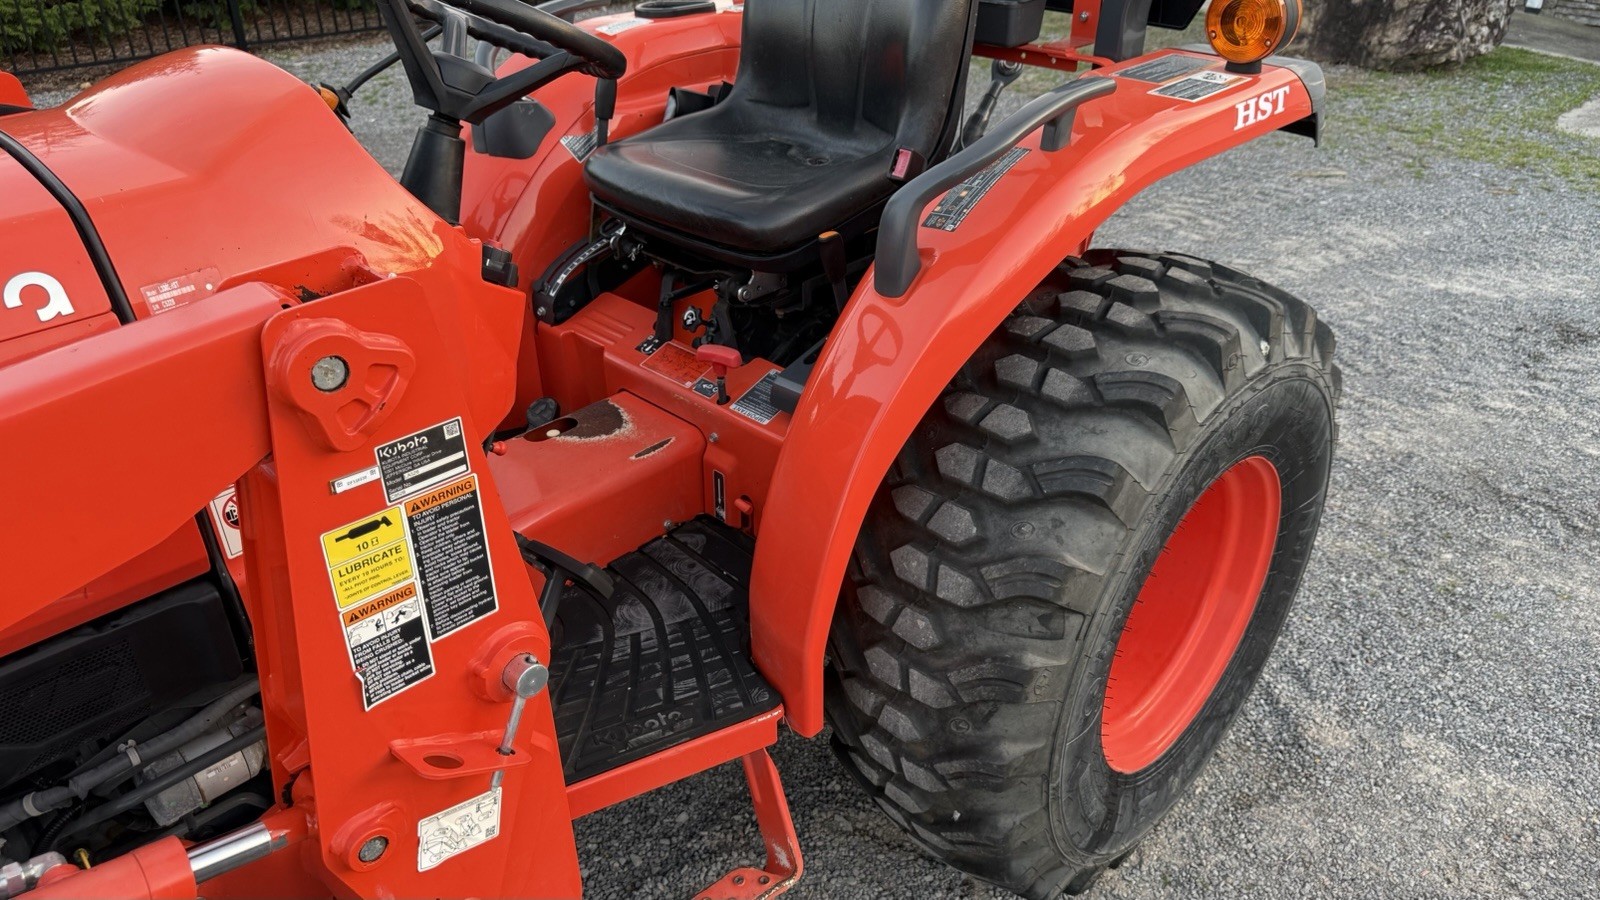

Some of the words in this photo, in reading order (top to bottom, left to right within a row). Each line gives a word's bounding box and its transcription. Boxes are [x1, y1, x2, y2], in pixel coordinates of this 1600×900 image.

[1234, 86, 1290, 131] HST
[732, 406, 766, 422] IMPORTANT
[379, 436, 428, 457] Kubota
[382, 456, 400, 465] KUBOTA
[388, 485, 403, 494] Serial
[420, 481, 472, 507] WARNING
[422, 506, 440, 516] AVOID
[441, 493, 472, 508] PERSONAL
[416, 521, 435, 531] Observe
[450, 505, 474, 518] precautions
[423, 526, 436, 534] loader
[446, 516, 460, 524] tractor
[356, 541, 369, 551] 10
[419, 536, 437, 545] Operate
[339, 545, 401, 577] LUBRICATE
[470, 554, 483, 562] bucket
[340, 575, 360, 587] EVERY
[371, 561, 392, 573] HOURS
[371, 577, 392, 588] CONTROL
[359, 588, 412, 616] WARNING
[363, 638, 380, 649] AVOID
[381, 628, 400, 640] INJURY
[354, 648, 371, 659] FROM
[372, 639, 390, 650] FALLS
[356, 653, 374, 664] BEING
